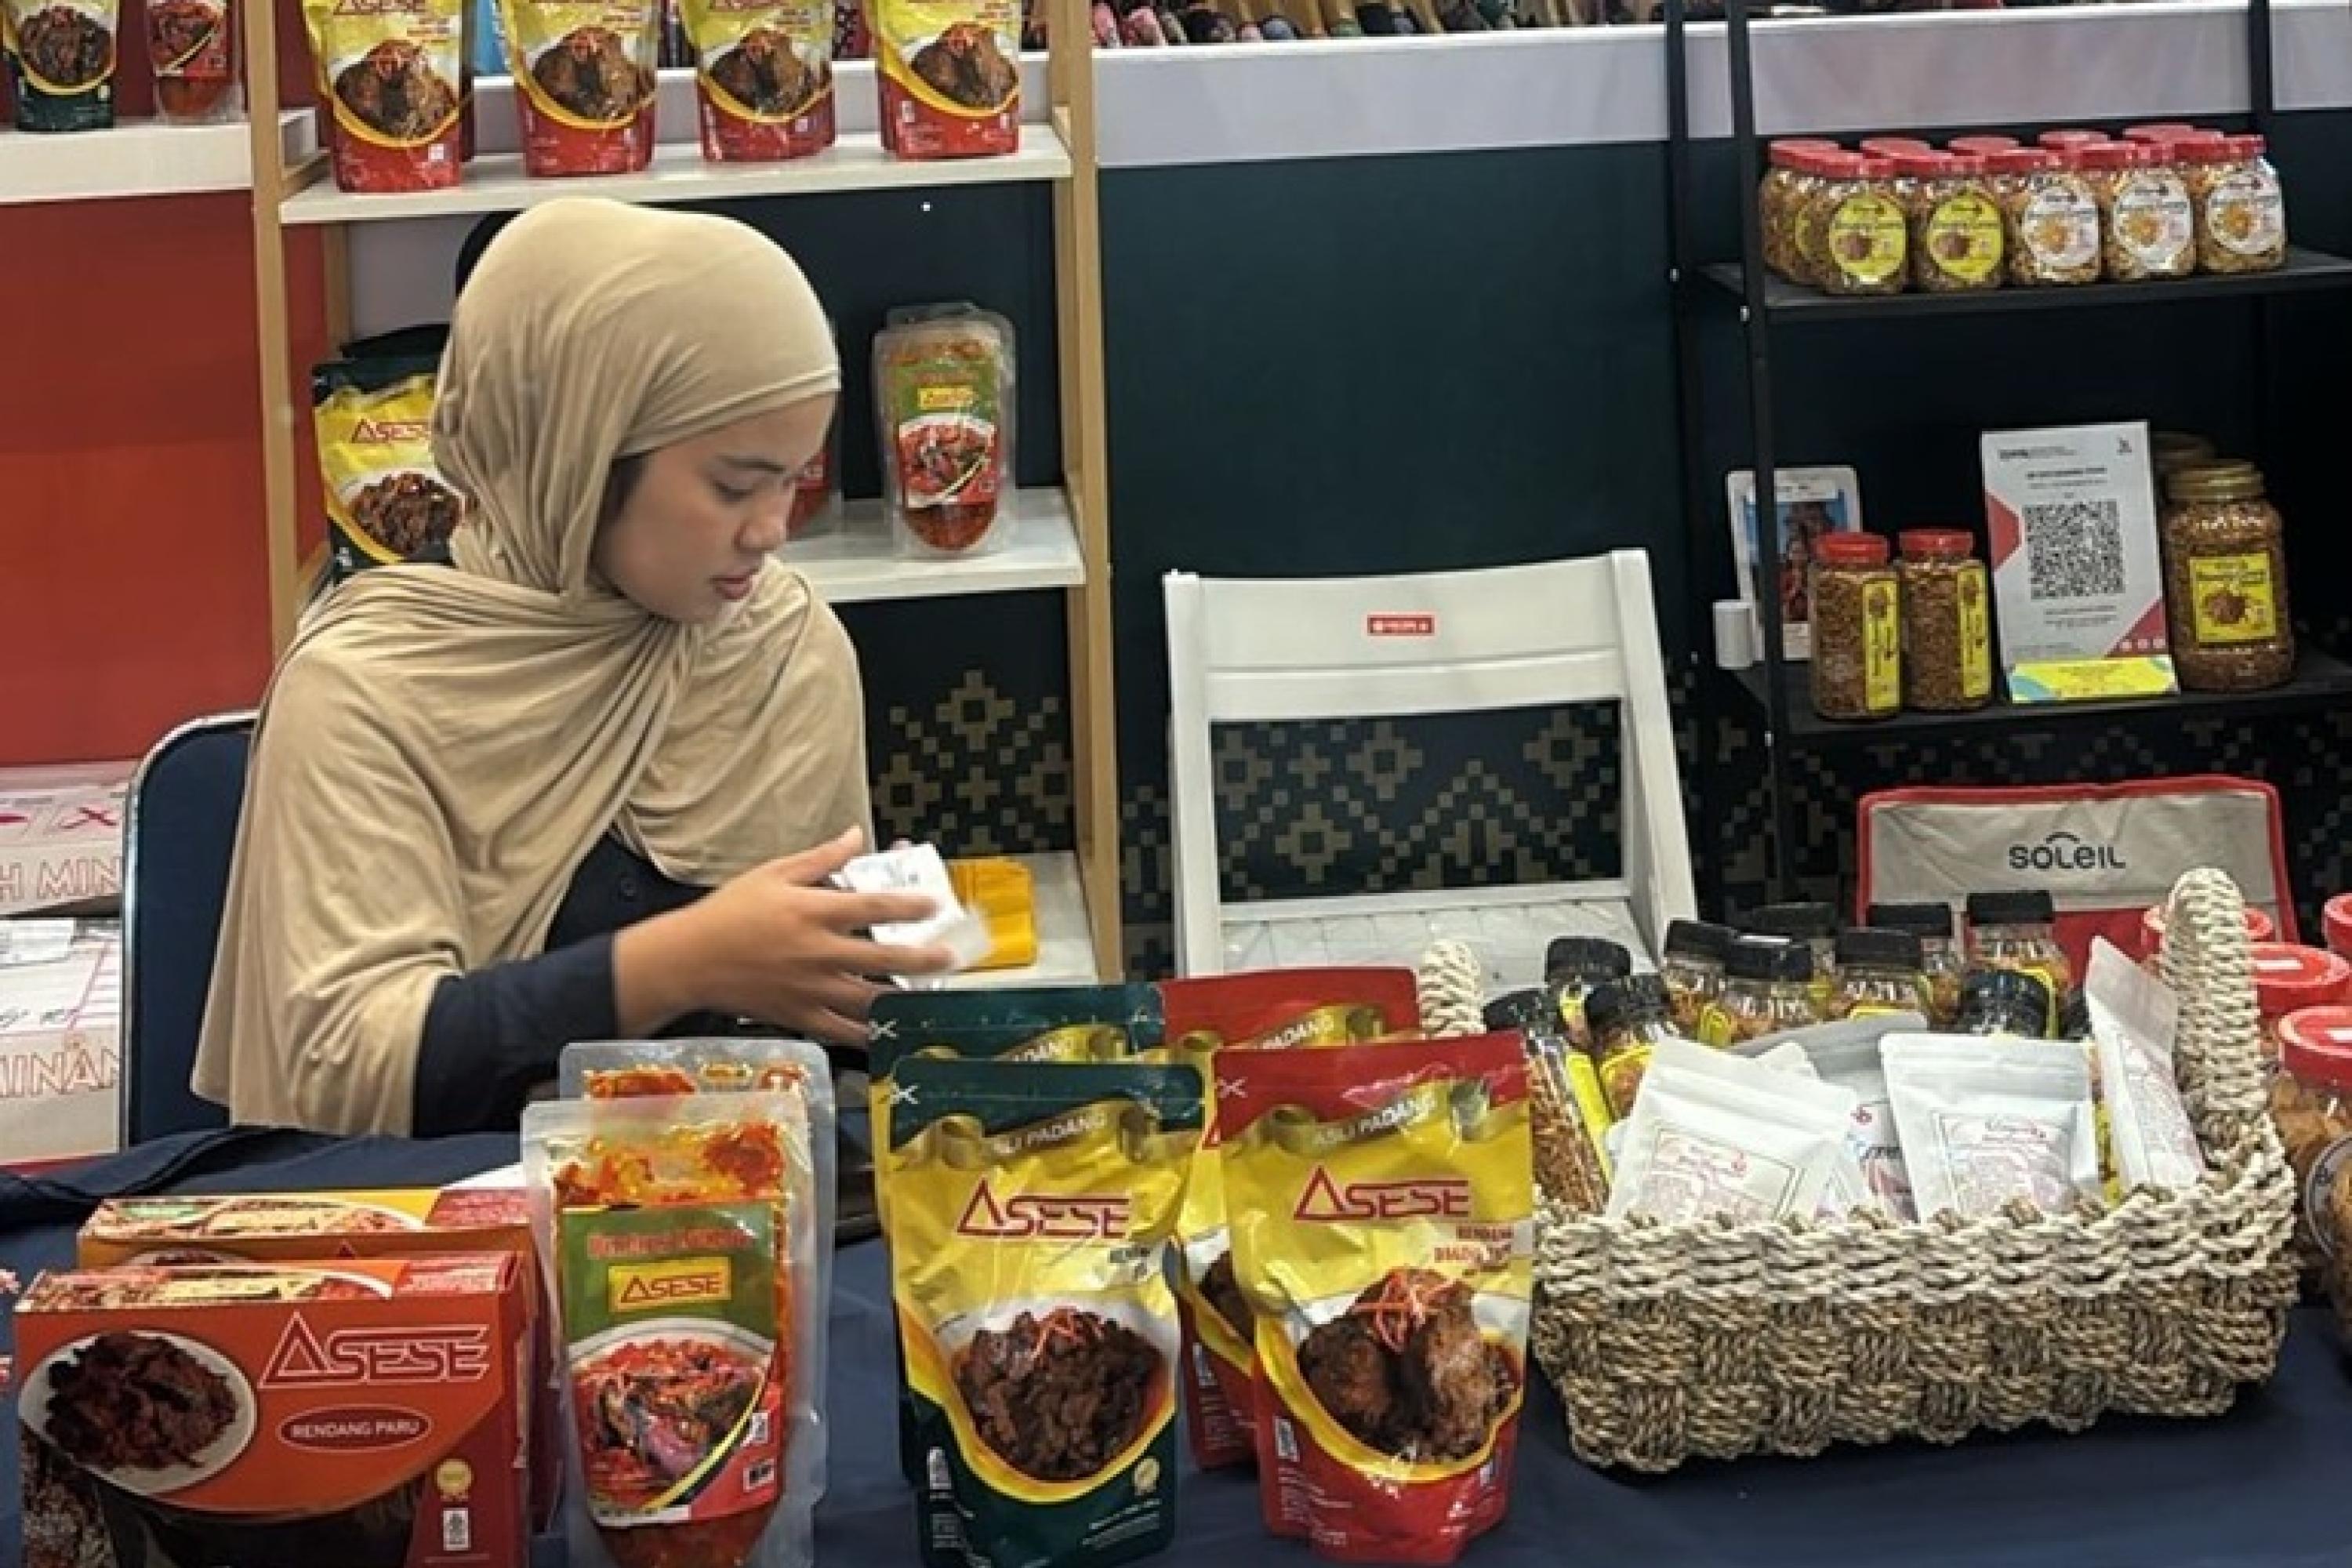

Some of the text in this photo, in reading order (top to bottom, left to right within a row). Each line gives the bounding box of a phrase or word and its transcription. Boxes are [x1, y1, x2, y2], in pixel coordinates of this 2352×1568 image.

[956, 1176, 1131, 1240] ASESE
[1294, 1164, 1469, 1221] ASESE
[619, 1271, 723, 1304] ASESE
[257, 1310, 491, 1389] ASESE
[290, 1418, 420, 1439] RENDANG PARU
